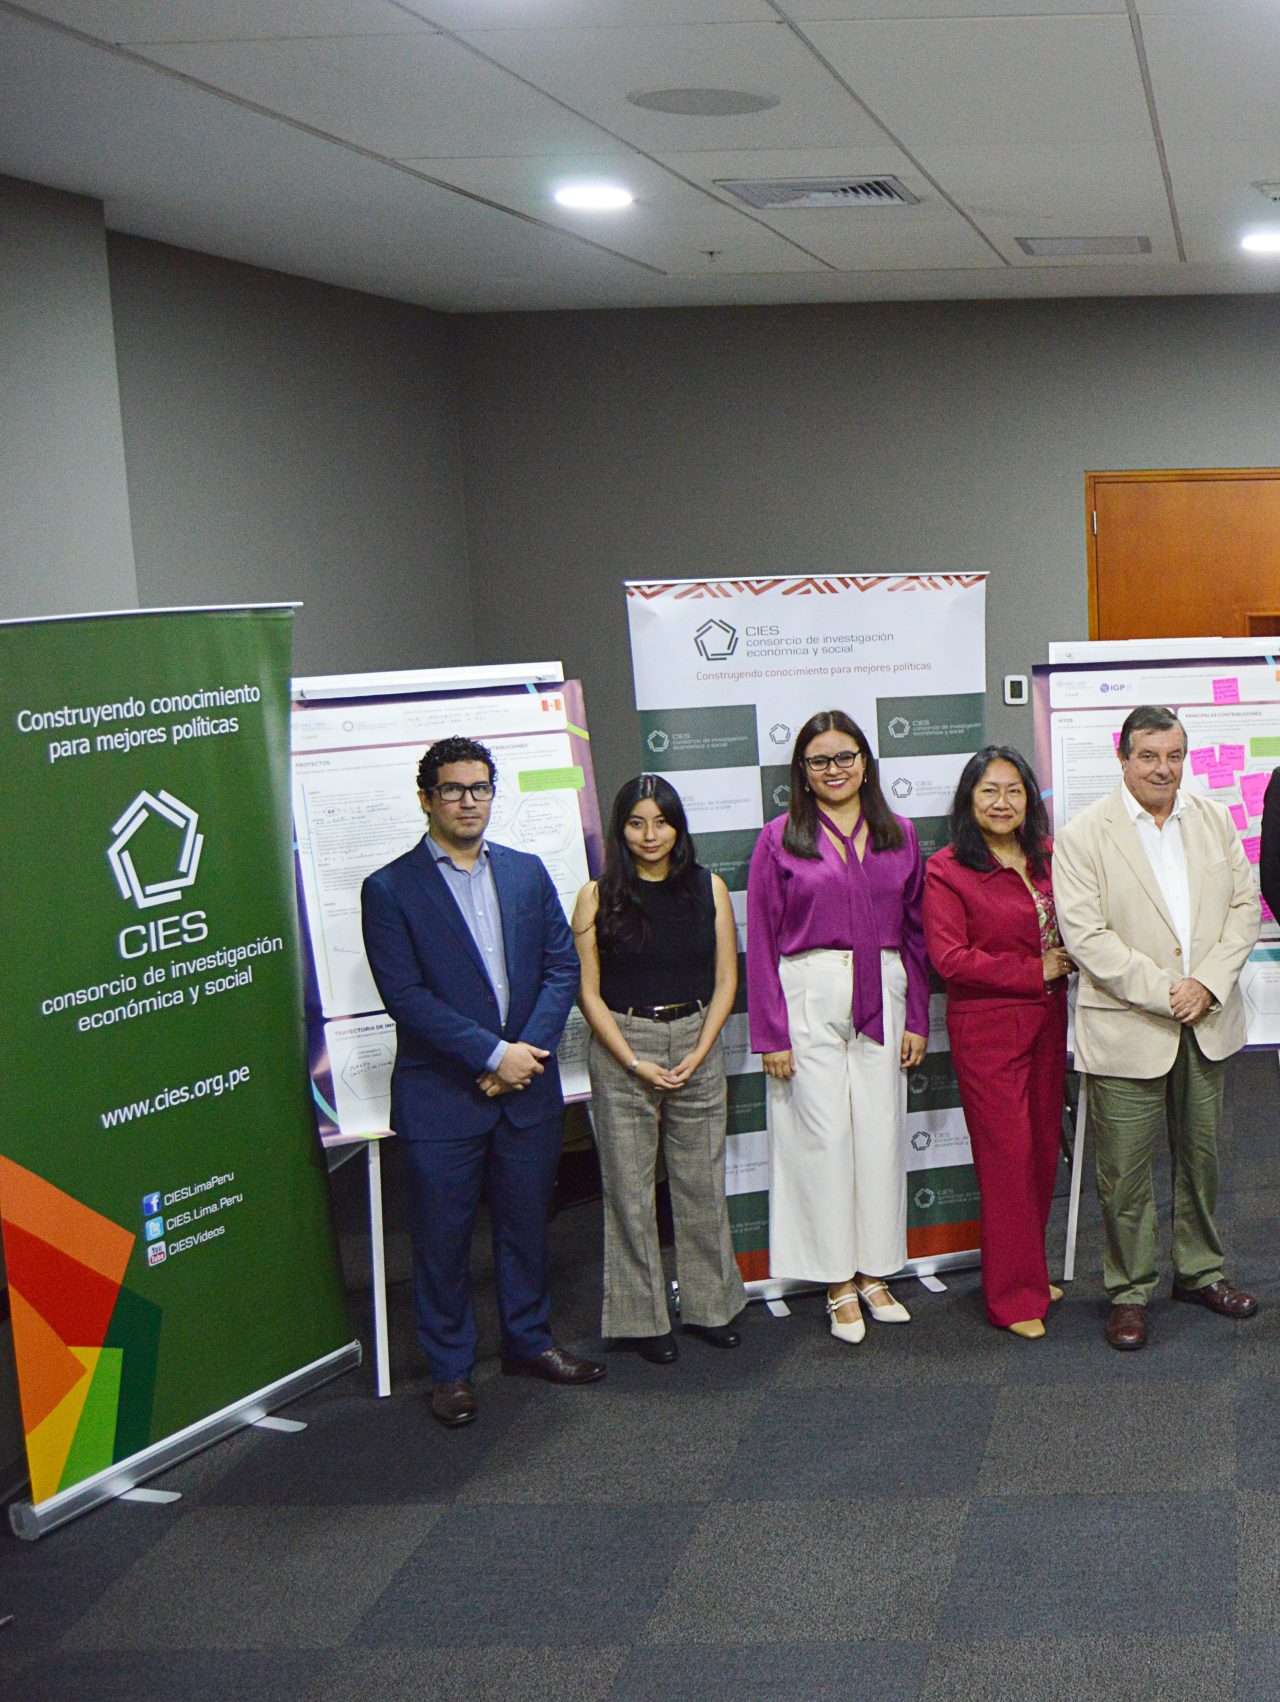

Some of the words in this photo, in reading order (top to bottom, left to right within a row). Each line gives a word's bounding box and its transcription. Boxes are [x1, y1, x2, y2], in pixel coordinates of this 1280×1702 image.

[745, 625, 780, 637] CIES
[746, 636, 801, 647] consorcio
[806, 635, 820, 645] de
[823, 632, 894, 645] investigación
[747, 646, 809, 658] económica
[812, 647, 819, 656] y
[821, 644, 853, 654] social
[696, 667, 763, 682] Construyendo
[765, 664, 829, 678] conocimiento
[831, 665, 851, 677] para
[853, 663, 891, 675] mejores
[893, 661, 932, 673] políticas
[17, 697, 145, 732] Construyendo
[150, 685, 260, 715] conocimiento
[49, 739, 90, 762] para
[96, 727, 167, 753] mejores
[172, 714, 239, 745] políticas
[118, 911, 209, 959] CIES
[42, 976, 137, 1015] consorcio
[143, 965, 166, 986] de
[171, 935, 283, 978] investigación
[78, 988, 184, 1032] económica
[189, 986, 200, 1004] y
[205, 966, 253, 996] social
[101, 1065, 250, 1129] www.cies.org.pe
[164, 1172, 234, 1206] CIESLimaPeru
[169, 1225, 225, 1255] CIESVideos
